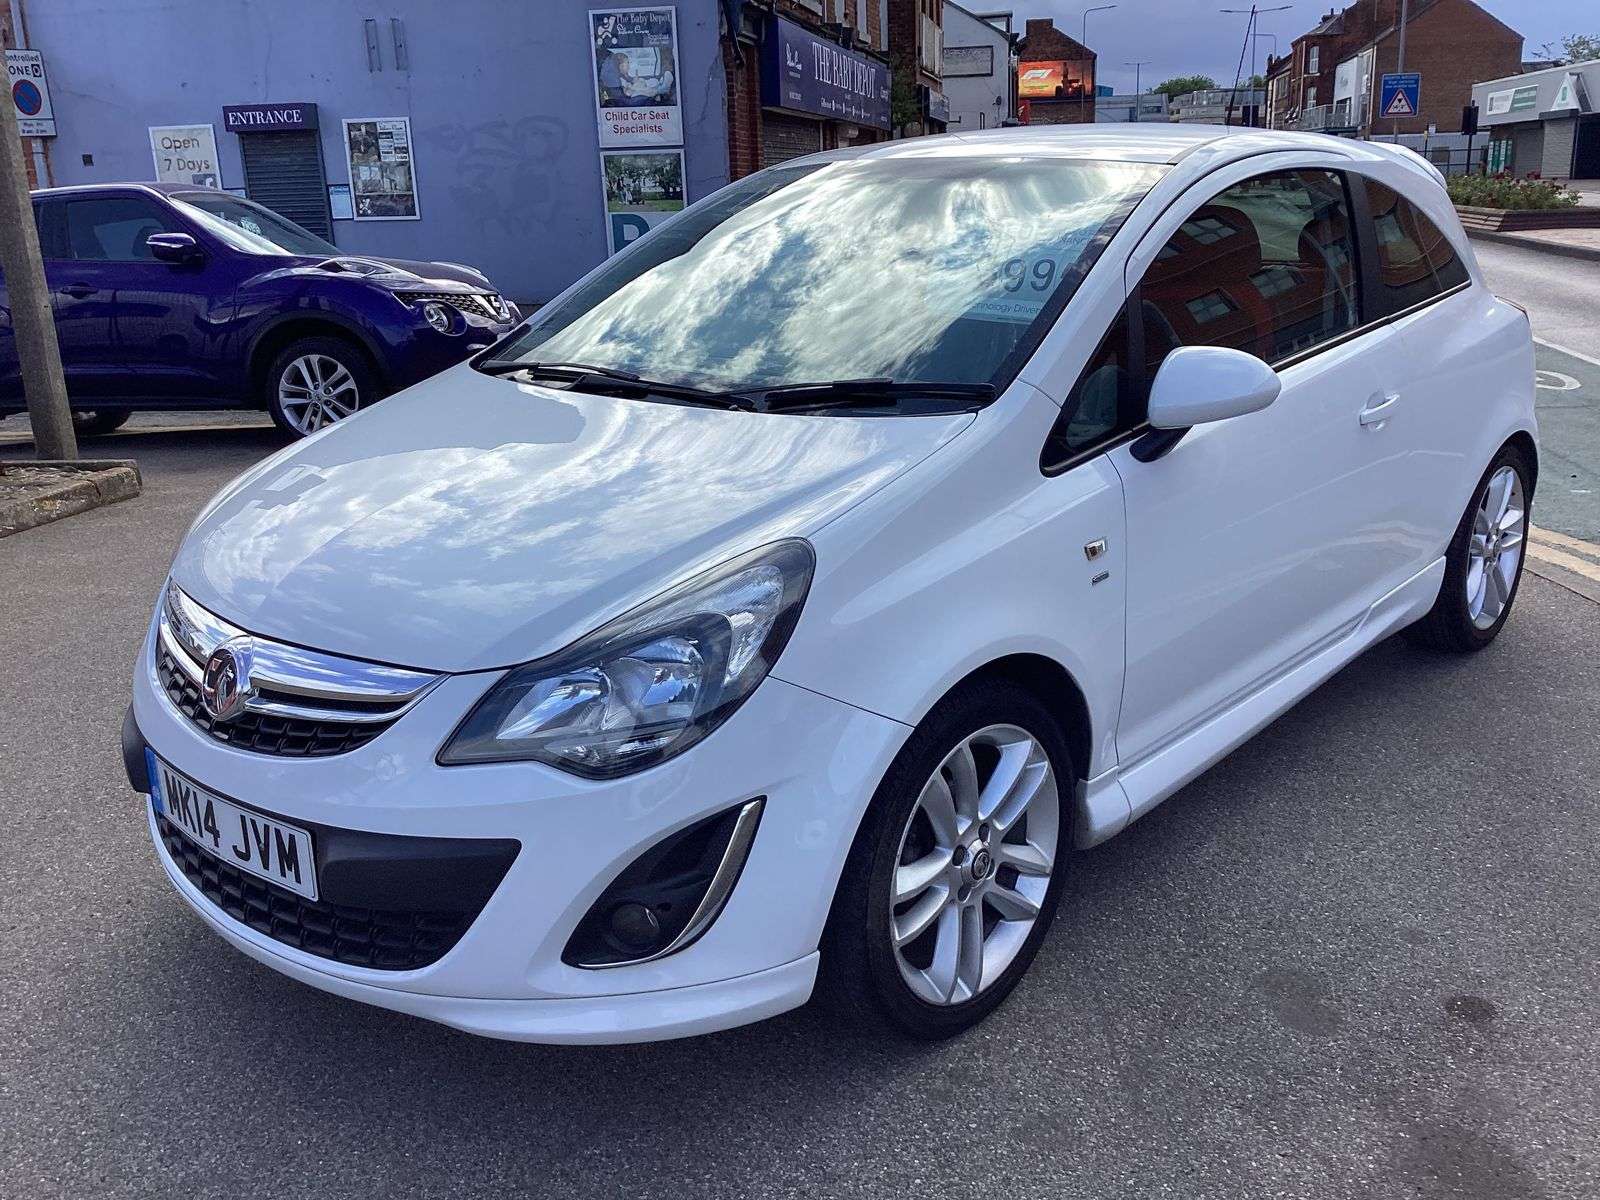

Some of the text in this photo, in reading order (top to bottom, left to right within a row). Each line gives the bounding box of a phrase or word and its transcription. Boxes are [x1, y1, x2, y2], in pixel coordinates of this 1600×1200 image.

[6, 54, 39, 62] ntrolled
[8, 65, 31, 75] ONE
[812, 41, 832, 84] THE
[833, 51, 853, 91] BABY
[854, 60, 876, 99] DEPOT
[229, 109, 302, 125] ENTRANCE
[605, 110, 670, 121] Child Car Seat
[613, 124, 664, 136] Specialists
[161, 136, 200, 151] Open
[164, 158, 210, 173] 7 Days
[163, 769, 302, 885] MK14 JVM
